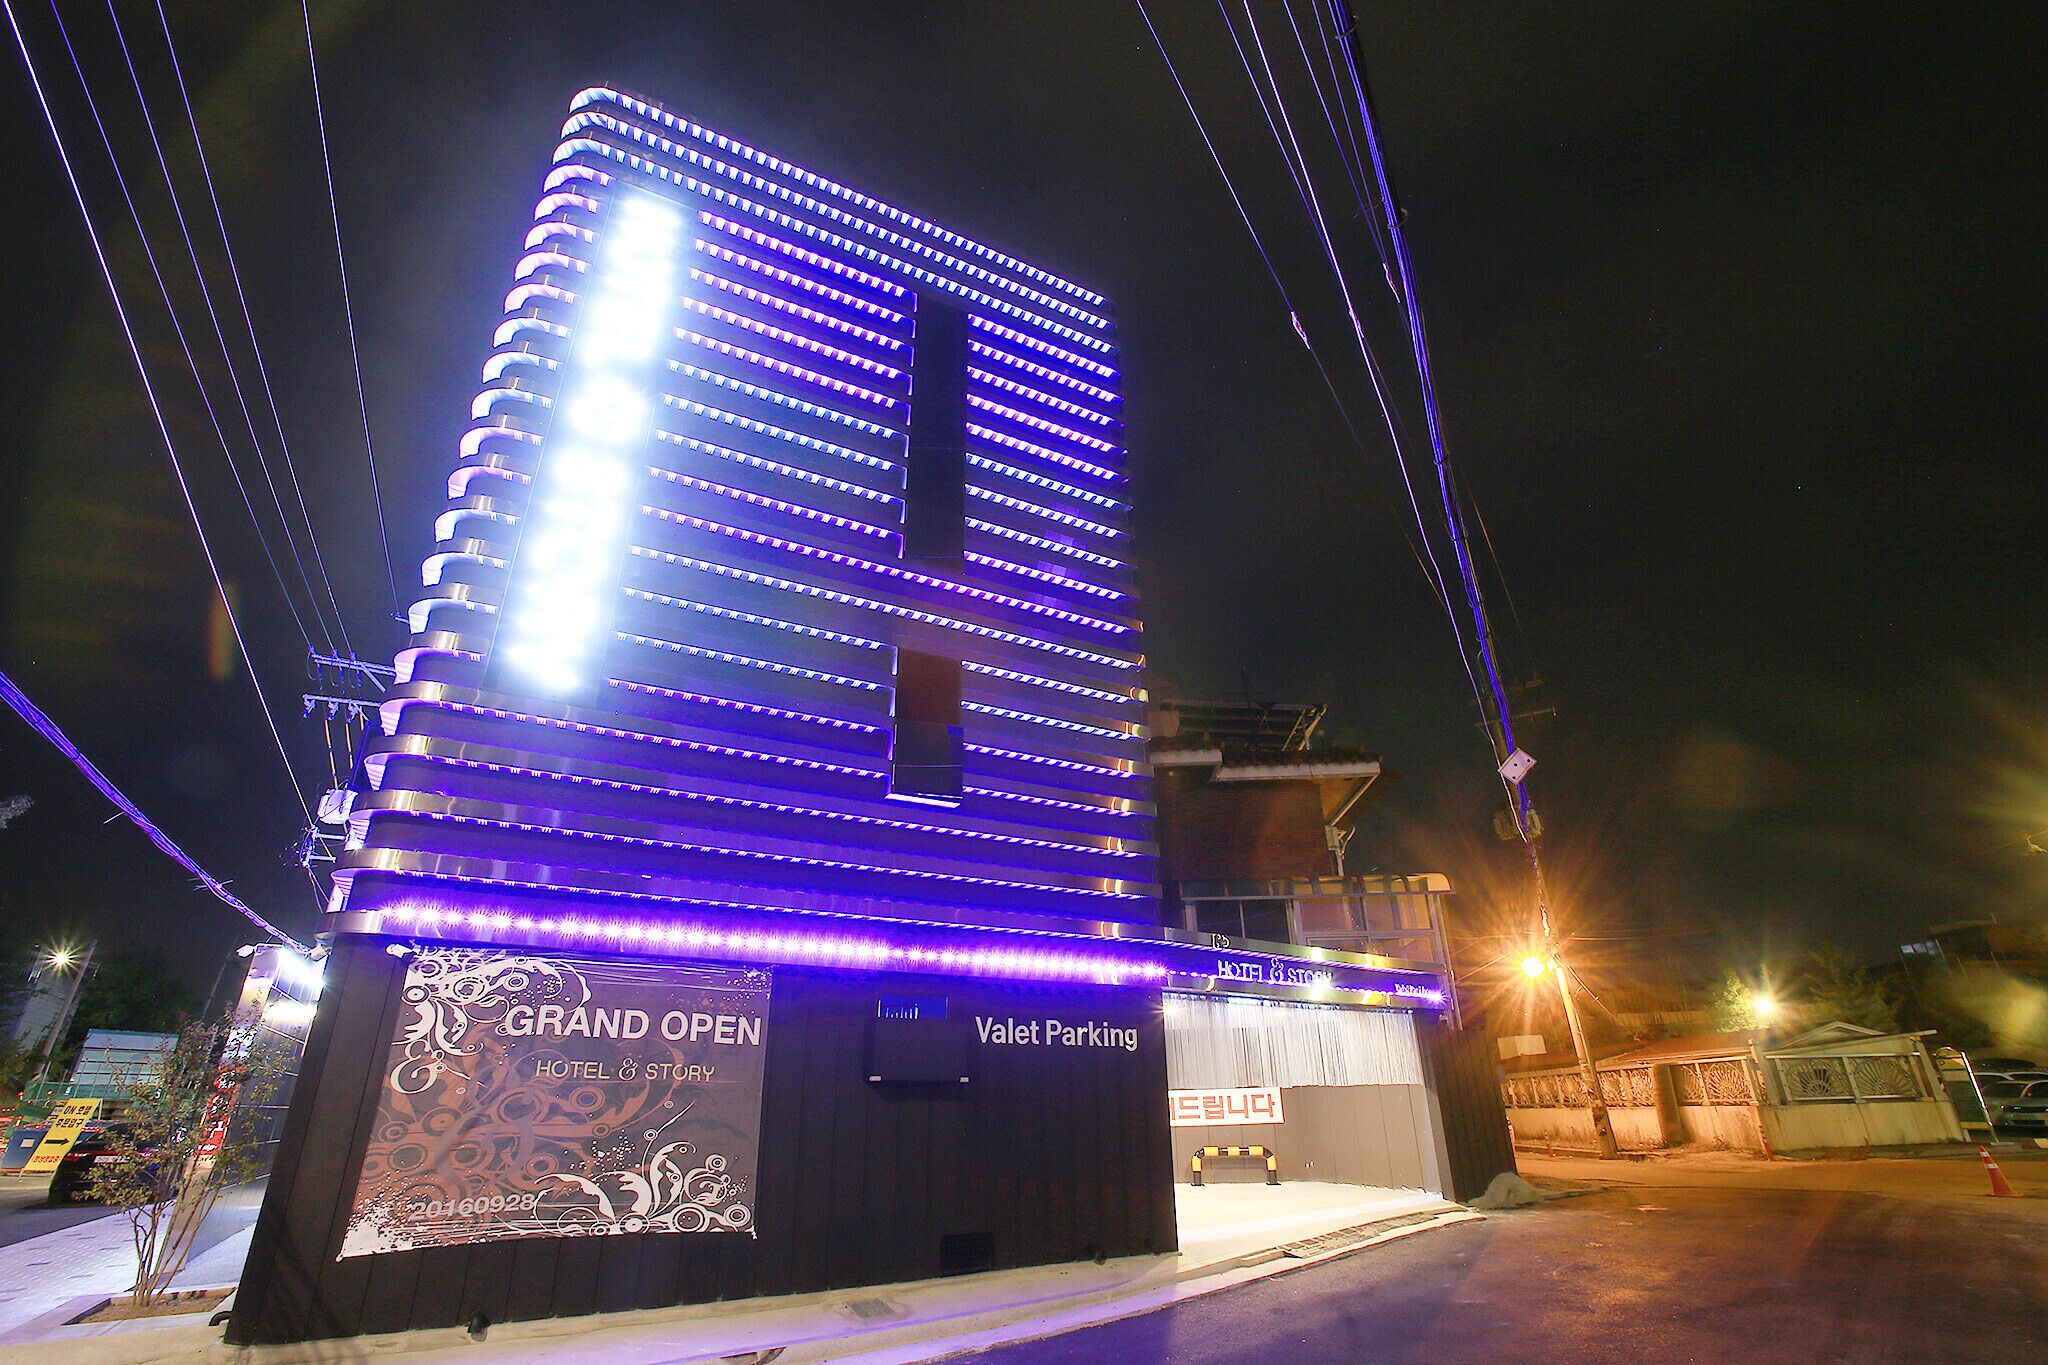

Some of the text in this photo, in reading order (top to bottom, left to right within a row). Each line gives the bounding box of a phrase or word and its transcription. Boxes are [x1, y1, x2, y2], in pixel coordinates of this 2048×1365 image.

[503, 1004, 762, 1046] GRAND OPEN
[974, 1016, 1138, 1052] Valet Parking
[535, 1057, 716, 1083] HOTEL & STORY
[408, 1193, 536, 1222] 20160928
